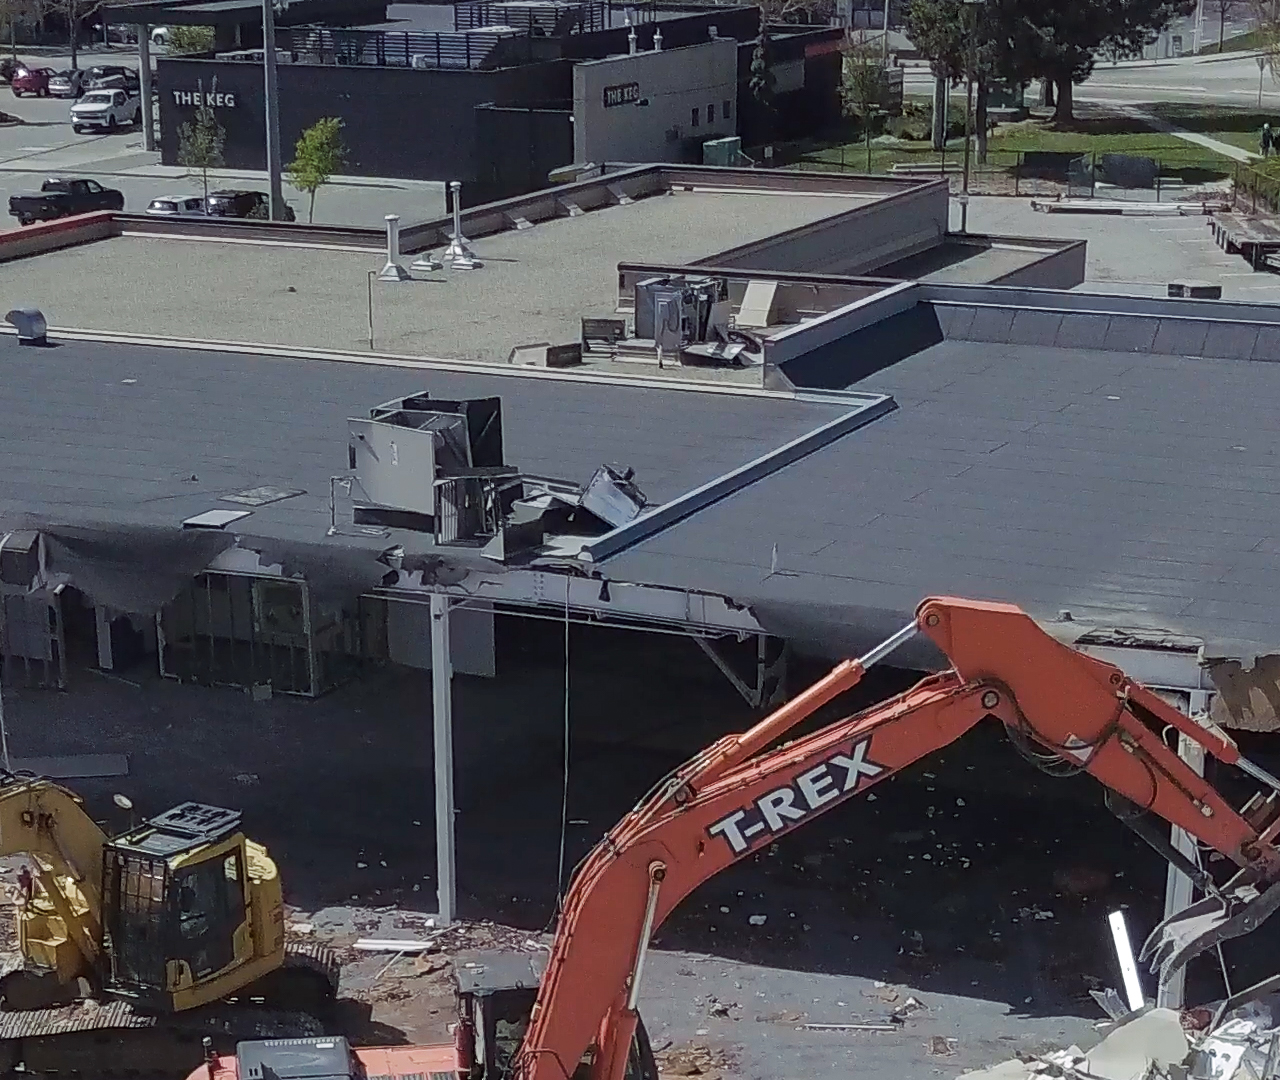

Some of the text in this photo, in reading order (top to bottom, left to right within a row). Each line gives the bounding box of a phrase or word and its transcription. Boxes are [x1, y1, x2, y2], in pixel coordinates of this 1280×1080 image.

[173, 91, 235, 107] THE KEG
[709, 739, 884, 853] T-REX
